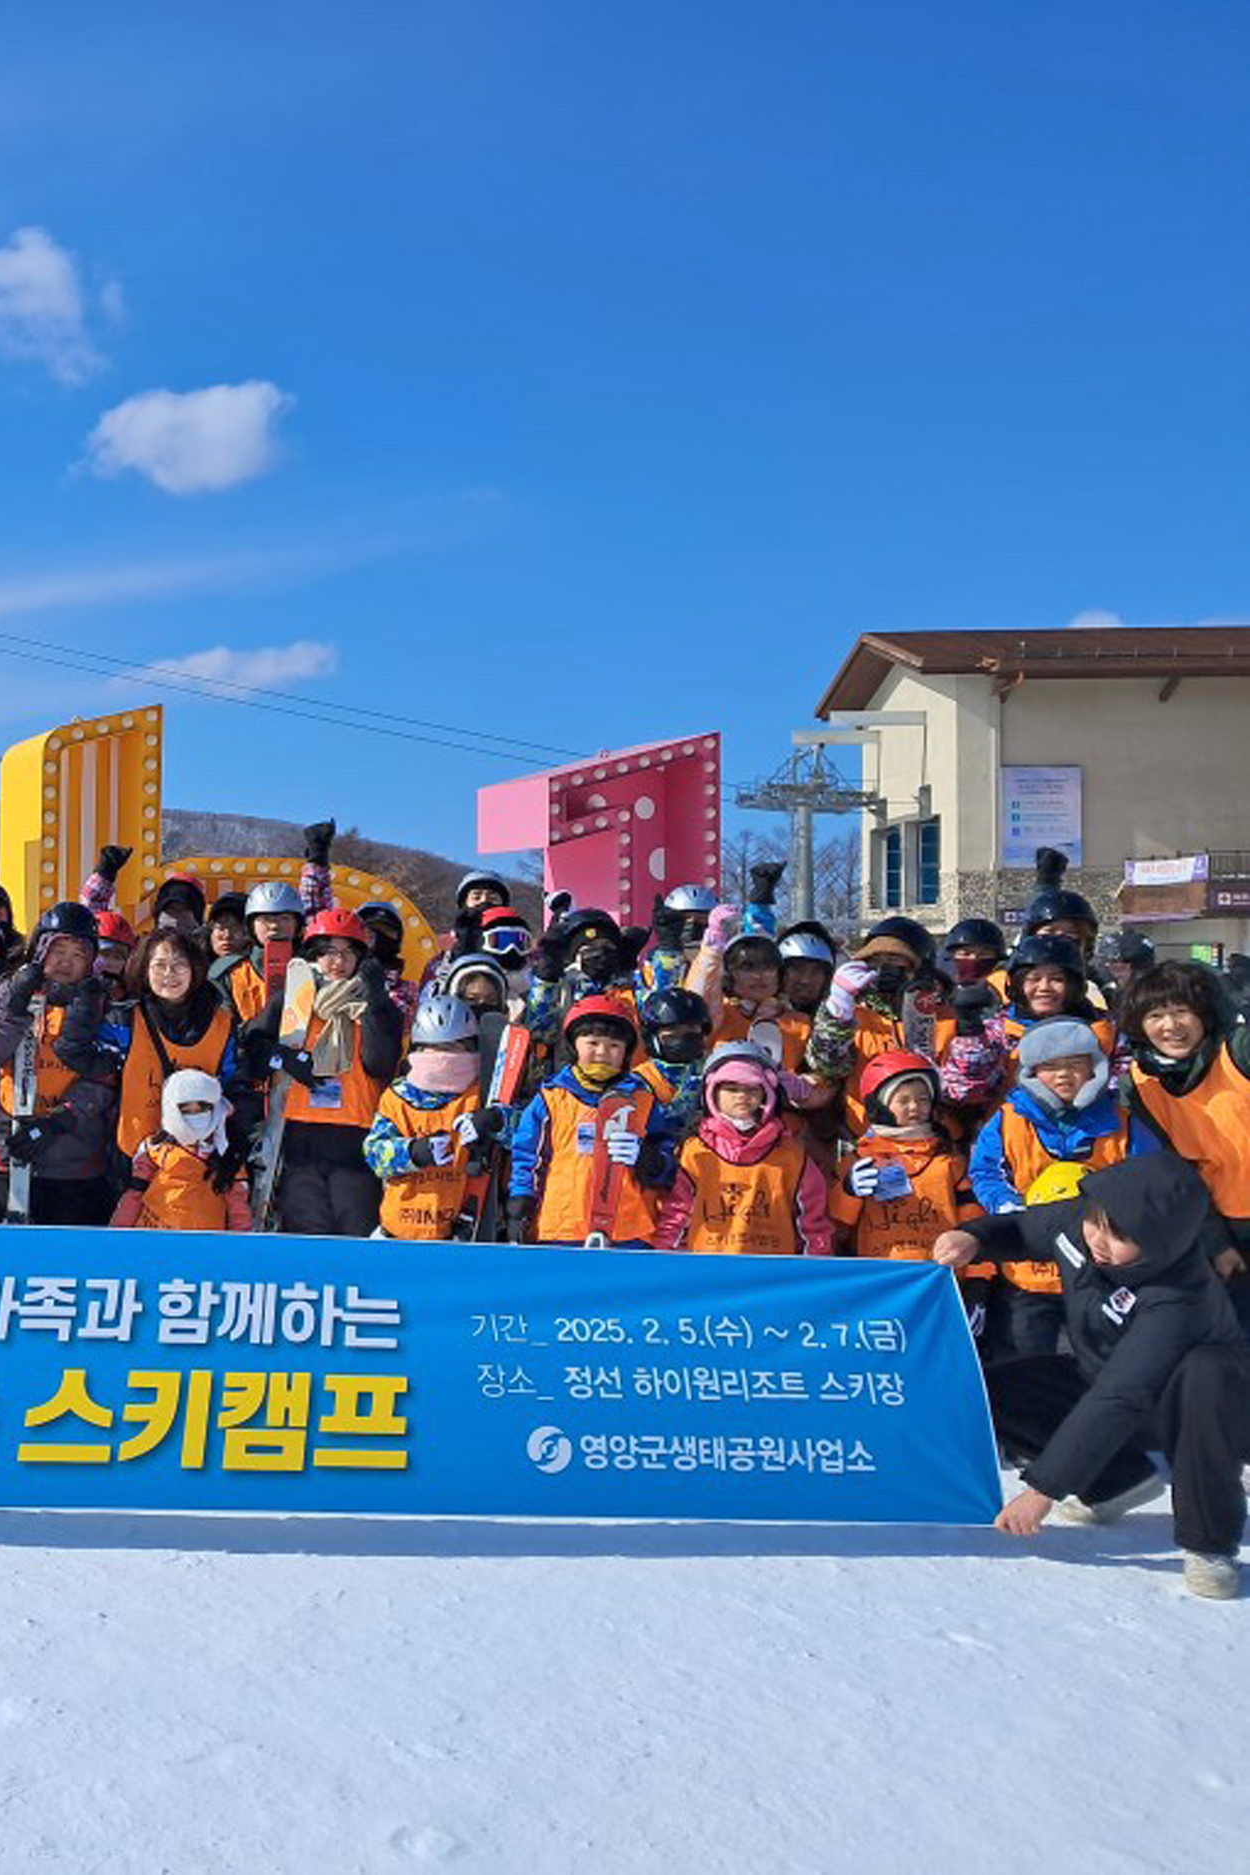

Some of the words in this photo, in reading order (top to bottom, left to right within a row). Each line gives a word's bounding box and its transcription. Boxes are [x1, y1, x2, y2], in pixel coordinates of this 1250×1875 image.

[157, 1278, 401, 1348] 함께하는
[471, 1313, 549, 1346] 기간_
[554, 1318, 633, 1344] 2025.
[642, 1318, 670, 1345] 2.
[678, 1315, 752, 1349] 5.(수)
[477, 1364, 554, 1400] 장소_
[563, 1366, 623, 1399] 정선
[632, 1366, 809, 1401] 하이원리조트
[819, 1372, 905, 1405] 스키장
[17, 1368, 408, 1471] 스키캠프
[580, 1435, 876, 1473] 영양군생태공원사업소
